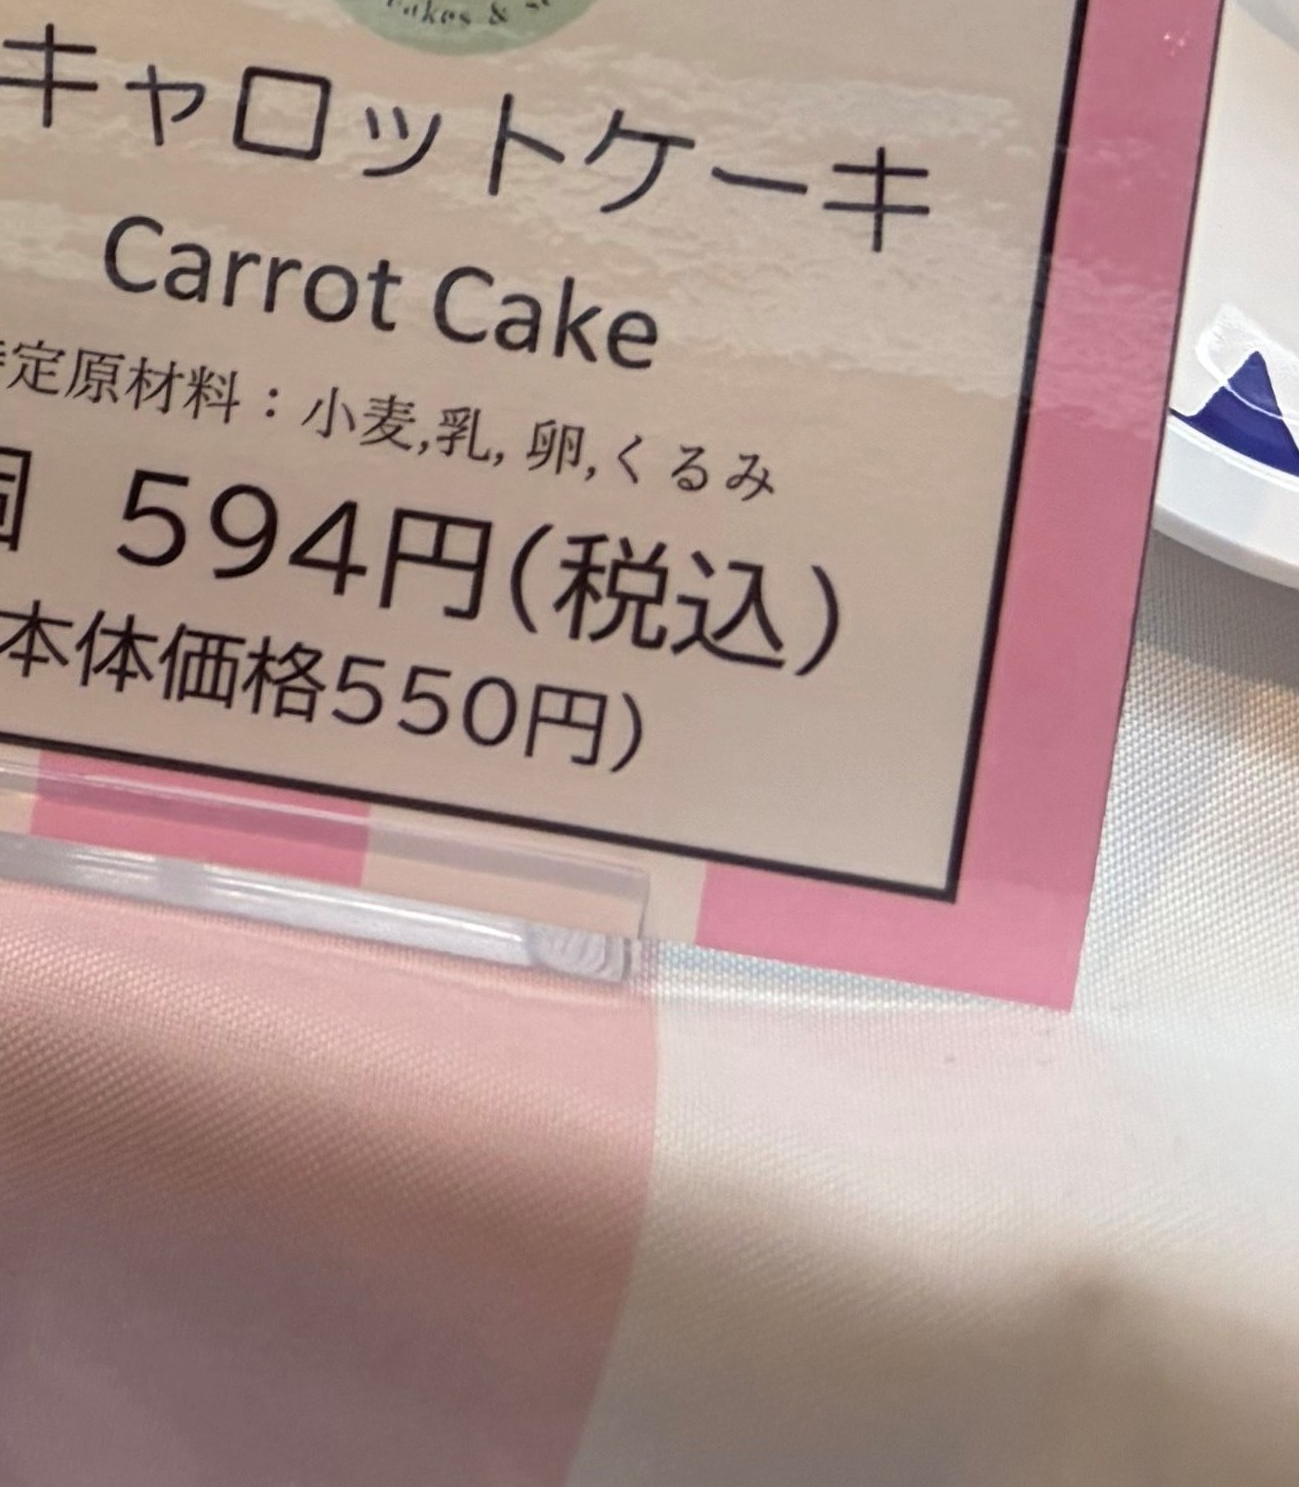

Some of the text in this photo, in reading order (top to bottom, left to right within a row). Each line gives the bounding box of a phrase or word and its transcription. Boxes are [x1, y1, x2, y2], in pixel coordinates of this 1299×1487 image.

[487, 0, 510, 27] &
[101, 214, 661, 371] Carrot Cake
[114, 467, 843, 678] 594円(税込)
